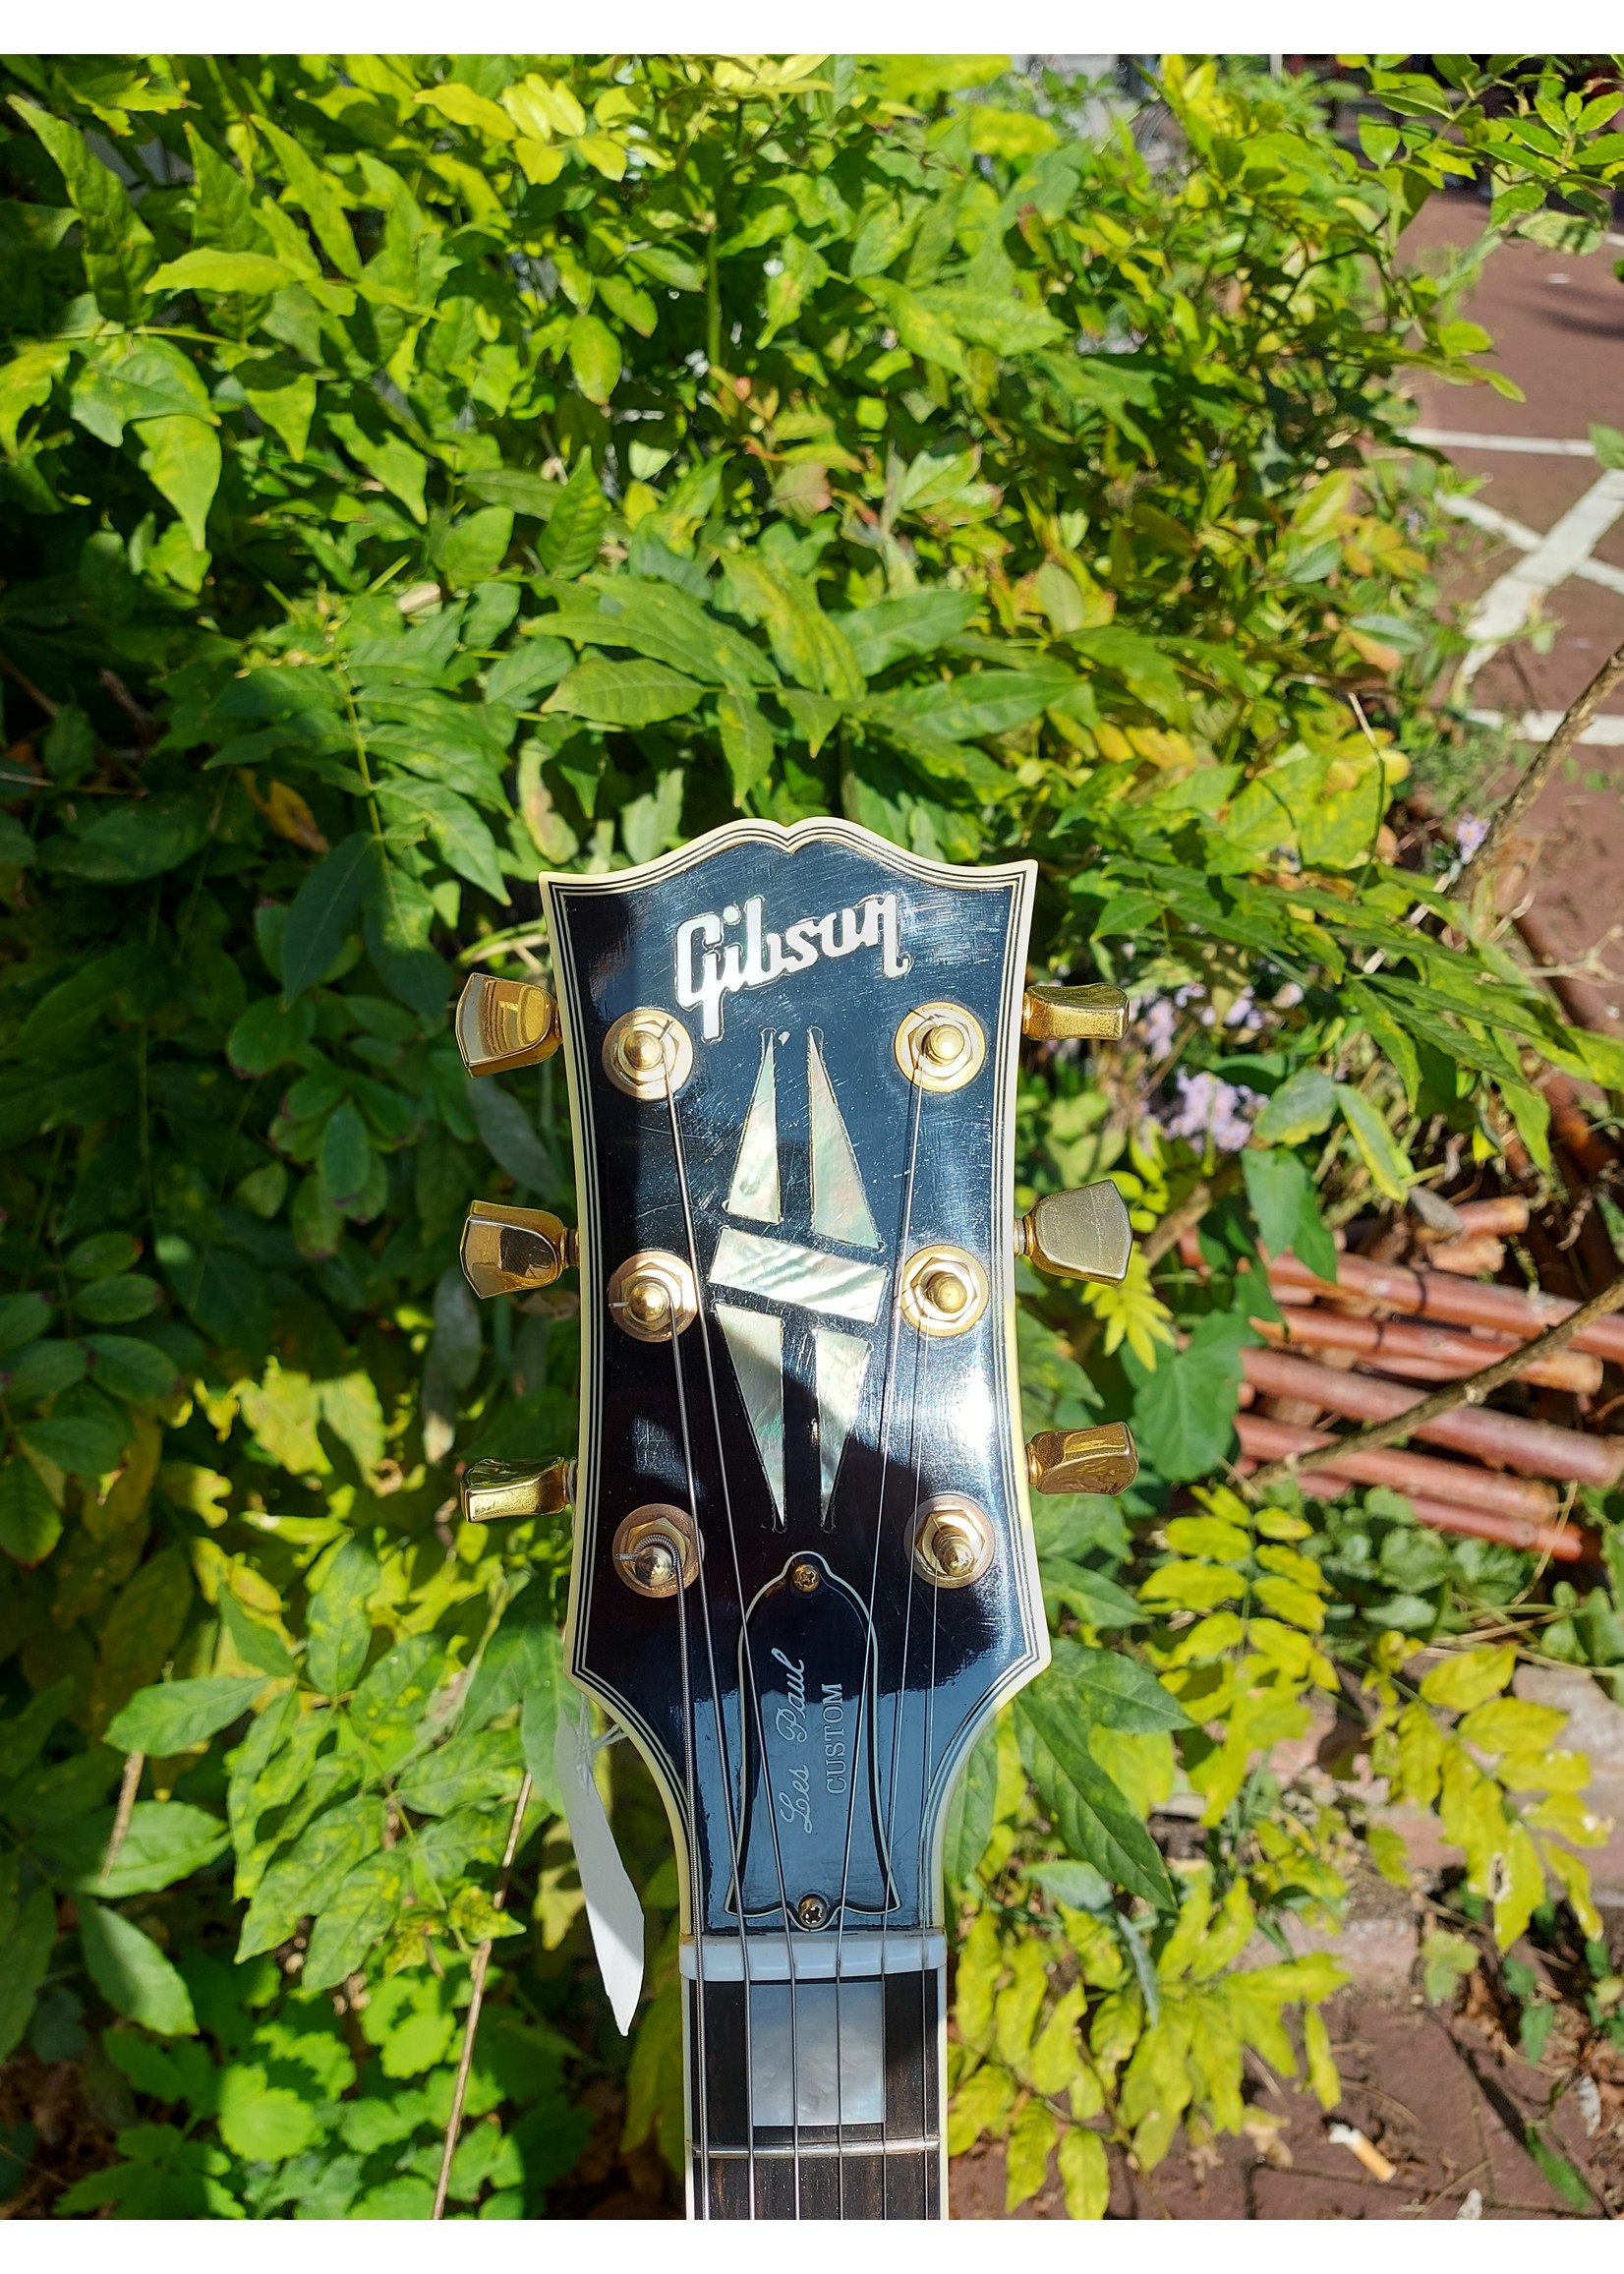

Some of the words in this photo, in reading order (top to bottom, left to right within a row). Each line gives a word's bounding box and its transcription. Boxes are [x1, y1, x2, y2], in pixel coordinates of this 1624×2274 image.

[675, 891, 912, 1043] Gibson
[771, 1647, 808, 1743] Paul
[821, 1683, 847, 1795] CUSTOM
[779, 1765, 813, 1835] Les
